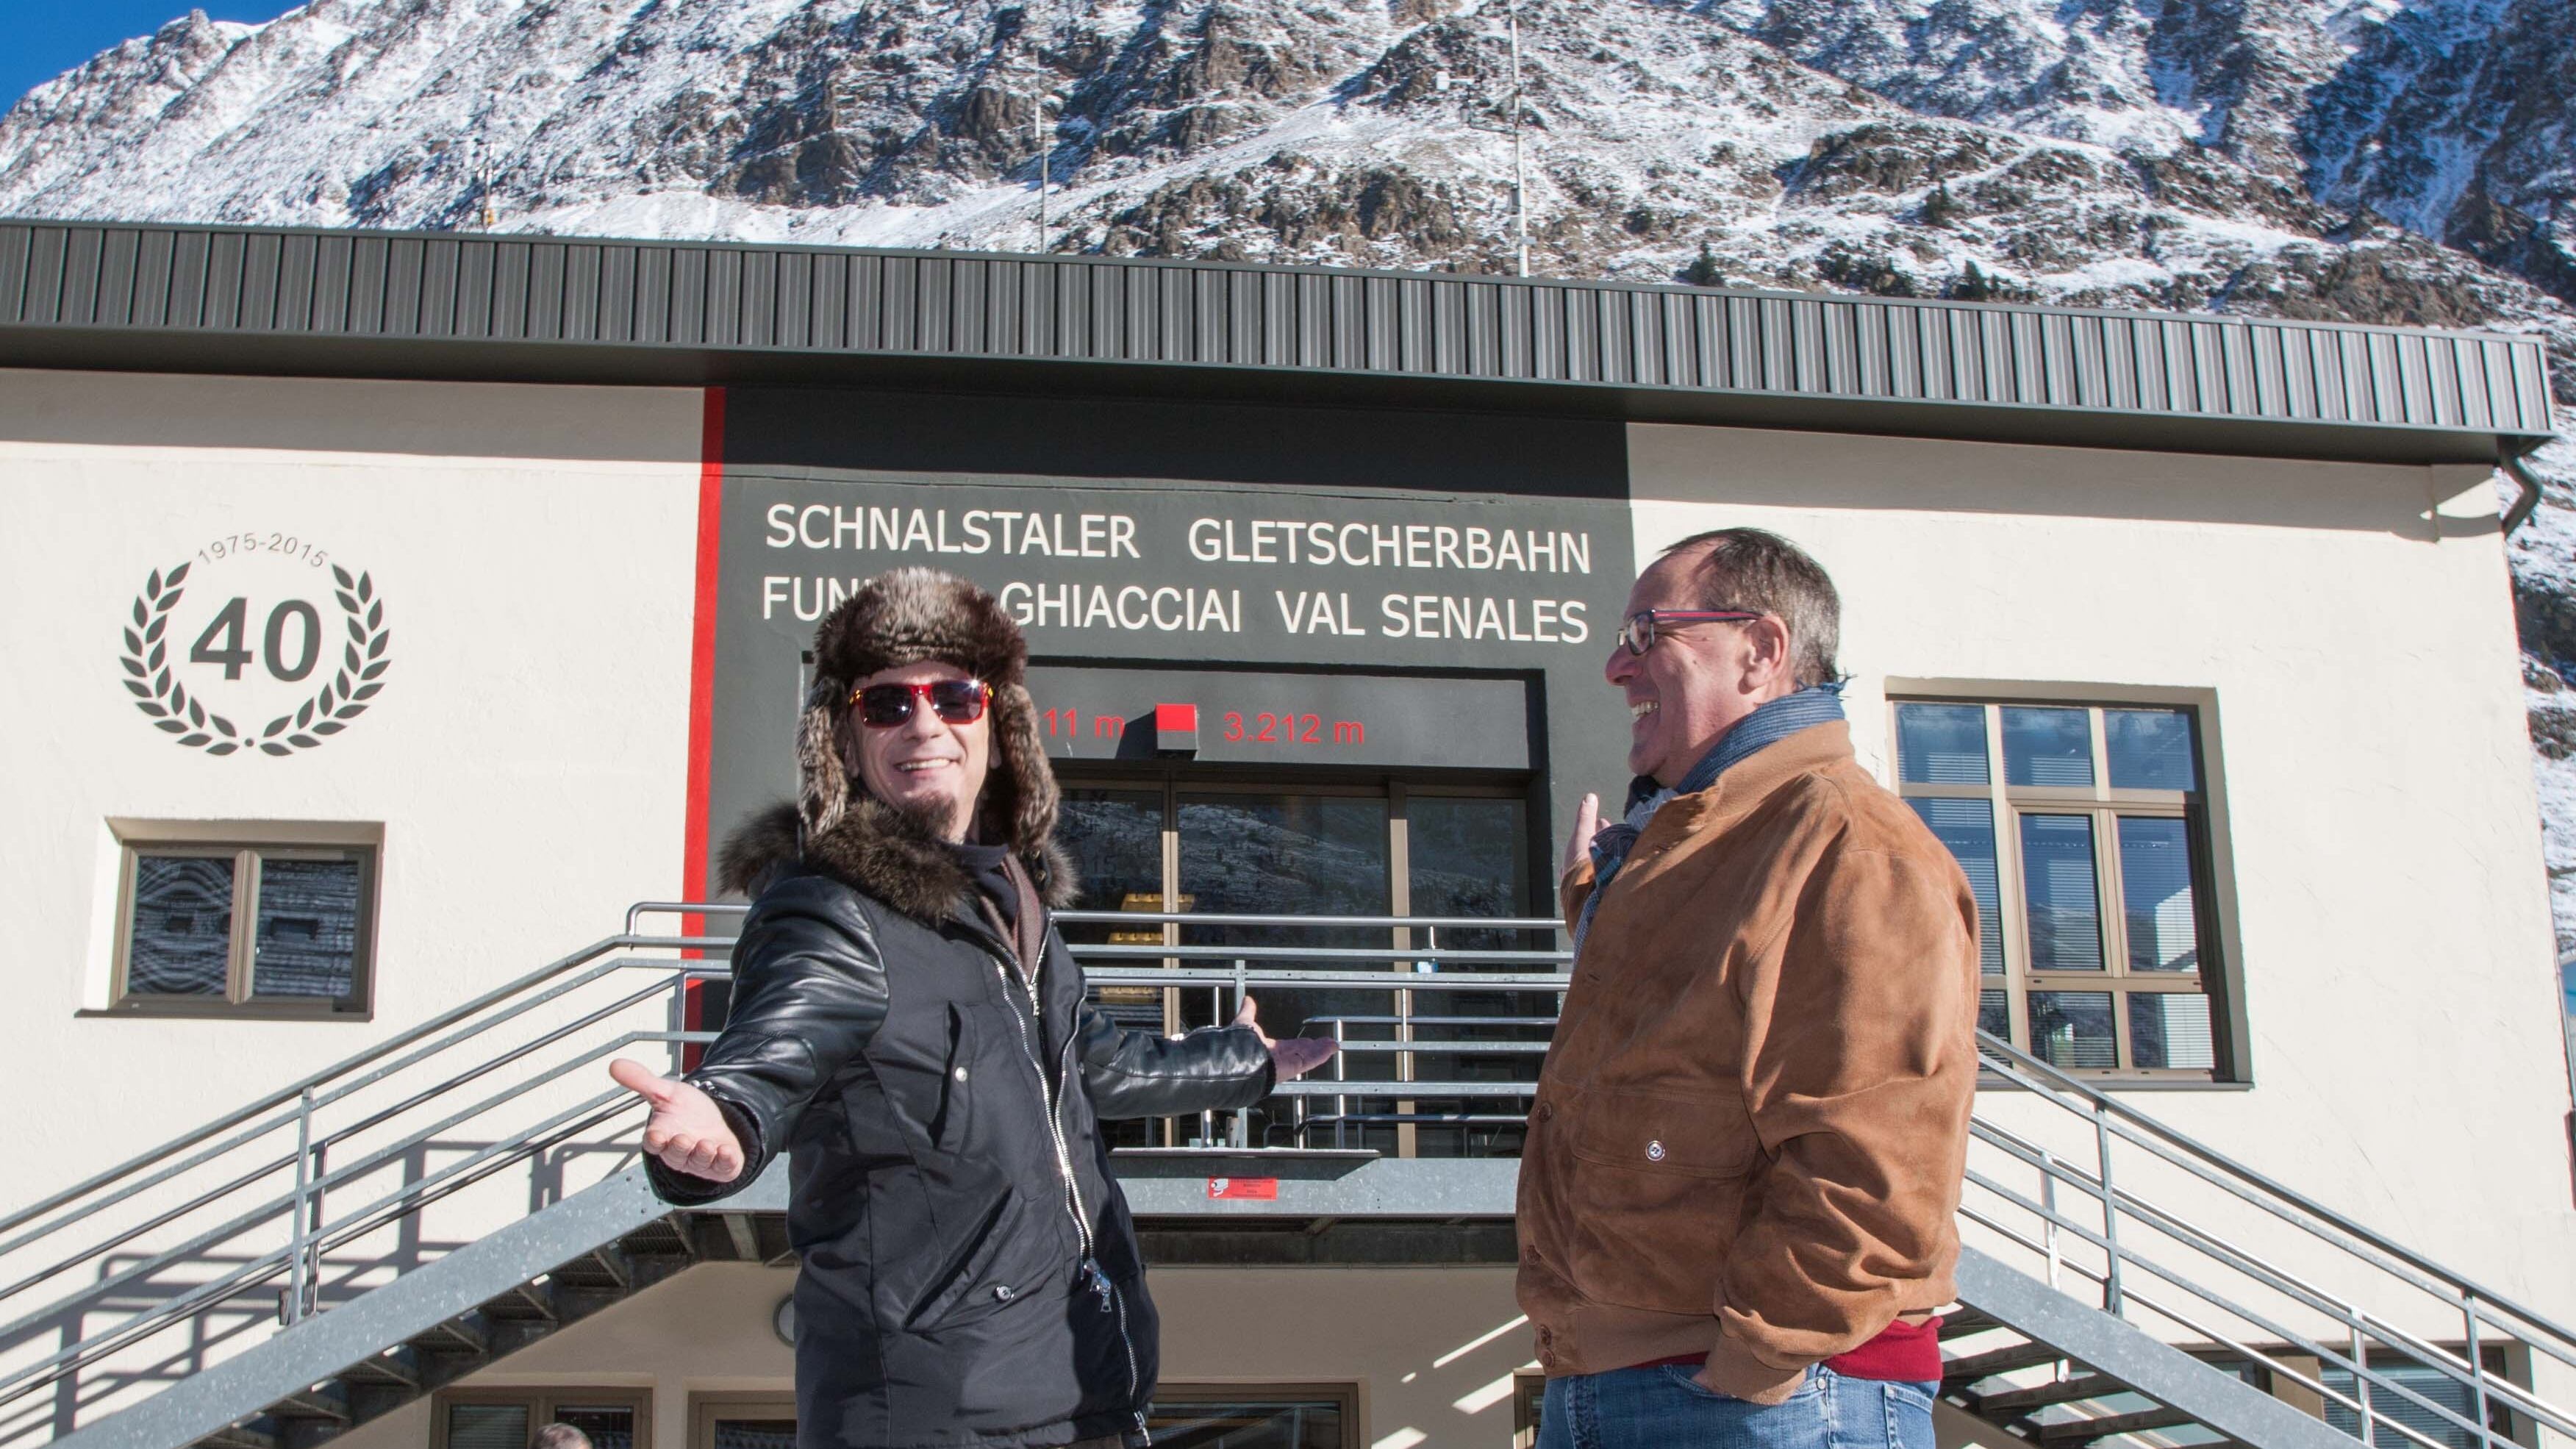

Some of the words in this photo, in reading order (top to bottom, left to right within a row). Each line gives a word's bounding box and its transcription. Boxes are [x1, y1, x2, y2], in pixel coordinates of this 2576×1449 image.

[198, 532, 329, 568] 1975-2015
[765, 503, 1141, 559] SCHNALSTALER
[1188, 518, 1591, 574] GLETSCHERBAHN
[190, 596, 322, 682] 40
[999, 582, 1241, 633] GHIACCIAI
[1275, 590, 1366, 636] VAL
[1381, 593, 1589, 644] SENALES
[1043, 707, 1078, 737] 11
[1094, 715, 1126, 739] m
[1223, 711, 1321, 743] 3.212
[1334, 720, 1365, 744] m
